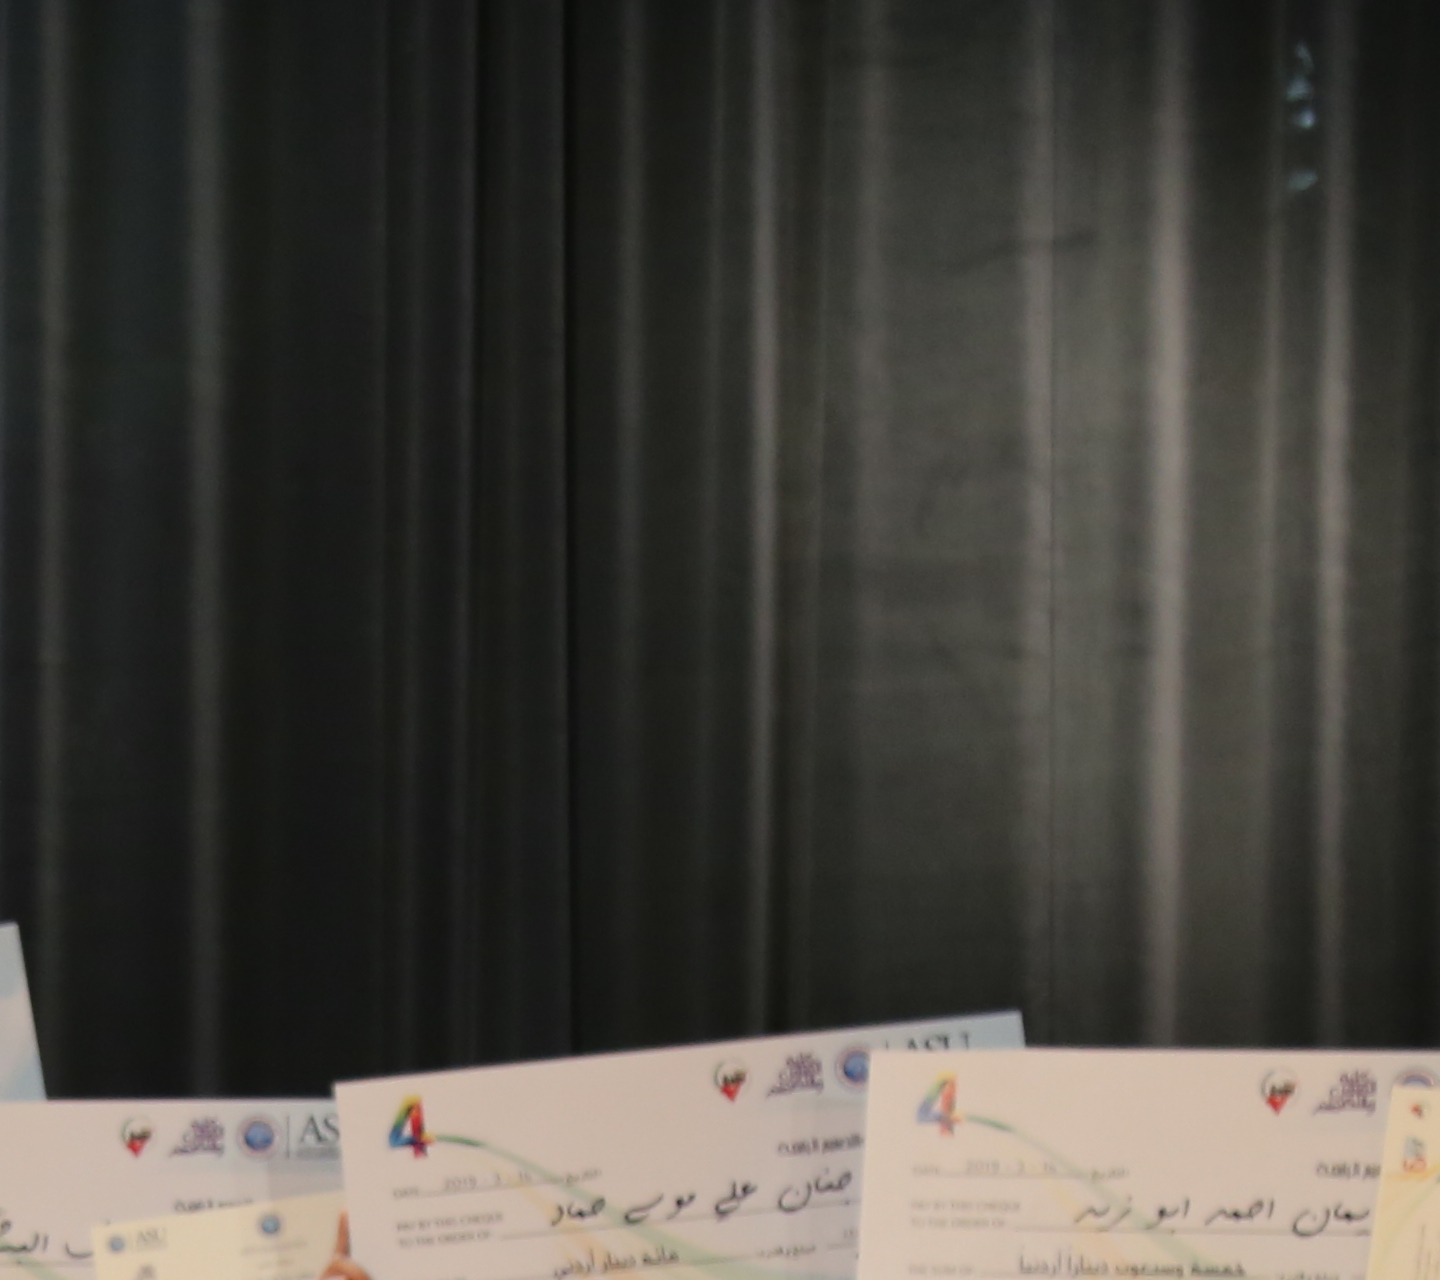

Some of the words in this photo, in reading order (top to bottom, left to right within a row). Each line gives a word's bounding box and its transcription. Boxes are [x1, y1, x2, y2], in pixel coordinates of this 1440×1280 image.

[299, 1113, 340, 1143] AS
[385, 1093, 435, 1160] 4
[913, 1071, 963, 1138] 4
